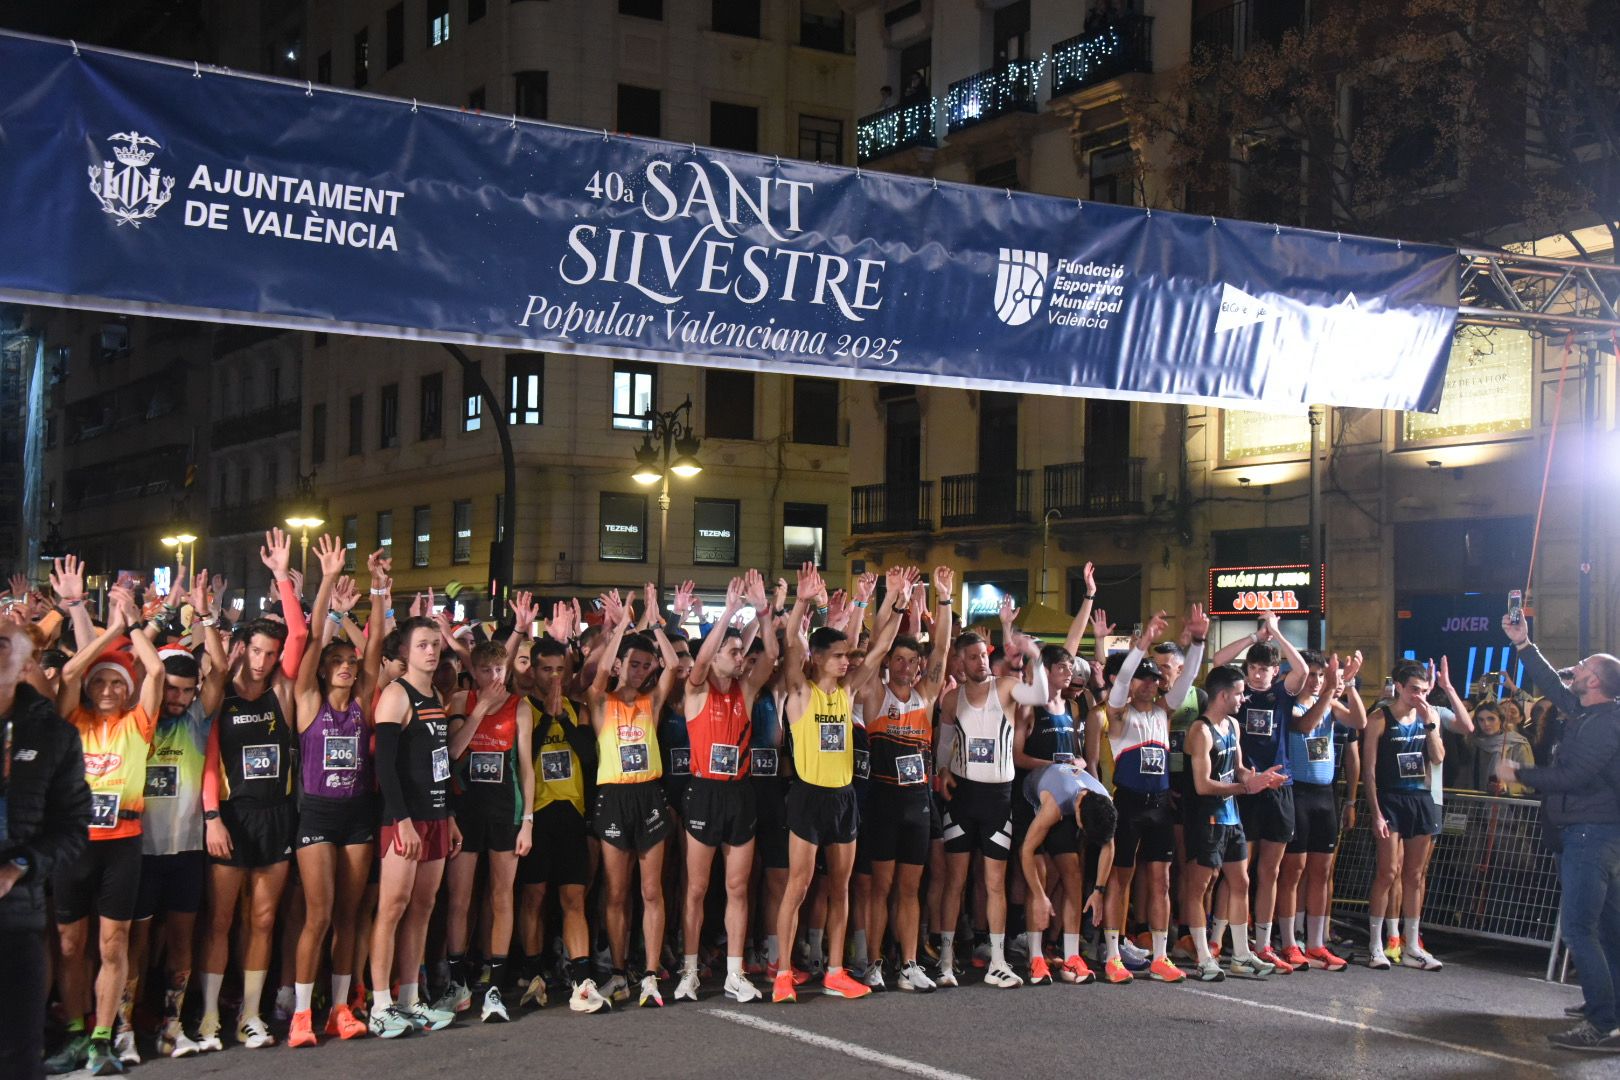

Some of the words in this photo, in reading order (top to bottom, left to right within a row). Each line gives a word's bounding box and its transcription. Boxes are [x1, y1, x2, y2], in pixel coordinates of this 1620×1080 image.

[188, 164, 404, 217] AJUNTAMENT
[642, 160, 814, 242] SANT
[184, 200, 229, 230] DE
[243, 207, 399, 252] VALÈNCIA
[559, 224, 886, 321] SILVESTRE
[1057, 258, 1124, 279] Fundació
[1053, 275, 1124, 296] Esportiva
[1049, 293, 1123, 315] Municipal
[1048, 310, 1109, 330] València
[519, 295, 653, 338] Popular
[666, 309, 826, 355] Valenciana
[827, 334, 902, 366] 2025
[605, 524, 639, 533] TEZENIS
[699, 529, 731, 538] TEZENIS
[1233, 590, 1299, 611] JOKER
[1441, 616, 1489, 632] JOKER
[1253, 719, 1266, 728] 29
[827, 734, 839, 744] 28
[330, 749, 353, 760] 206
[975, 747, 988, 757] 19
[254, 757, 270, 769] 20
[629, 754, 642, 764] 13
[721, 756, 728, 766] 4
[756, 758, 774, 768] 125
[477, 763, 498, 773] 196
[550, 762, 563, 772] 21
[905, 765, 918, 776] 24
[1405, 761, 1418, 771] 98
[150, 777, 167, 788] 45
[93, 806, 111, 817] 17
